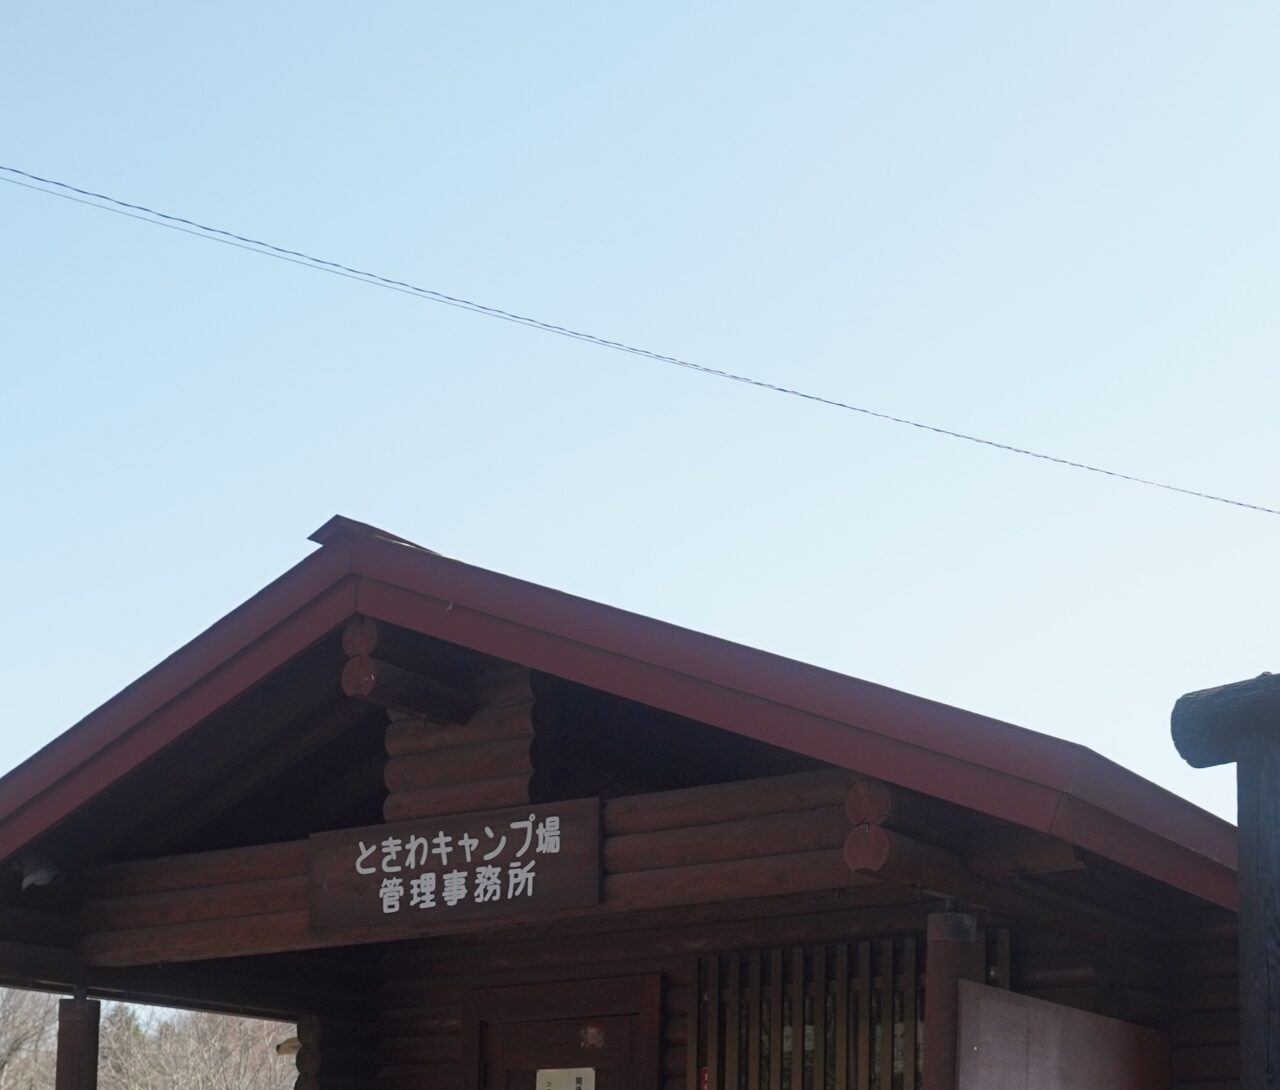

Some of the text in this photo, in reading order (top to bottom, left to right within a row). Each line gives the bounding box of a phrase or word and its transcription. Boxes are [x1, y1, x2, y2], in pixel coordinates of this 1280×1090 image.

[355, 813, 561, 875] ときわキャンプ場
[379, 859, 536, 914] 管理事務所
